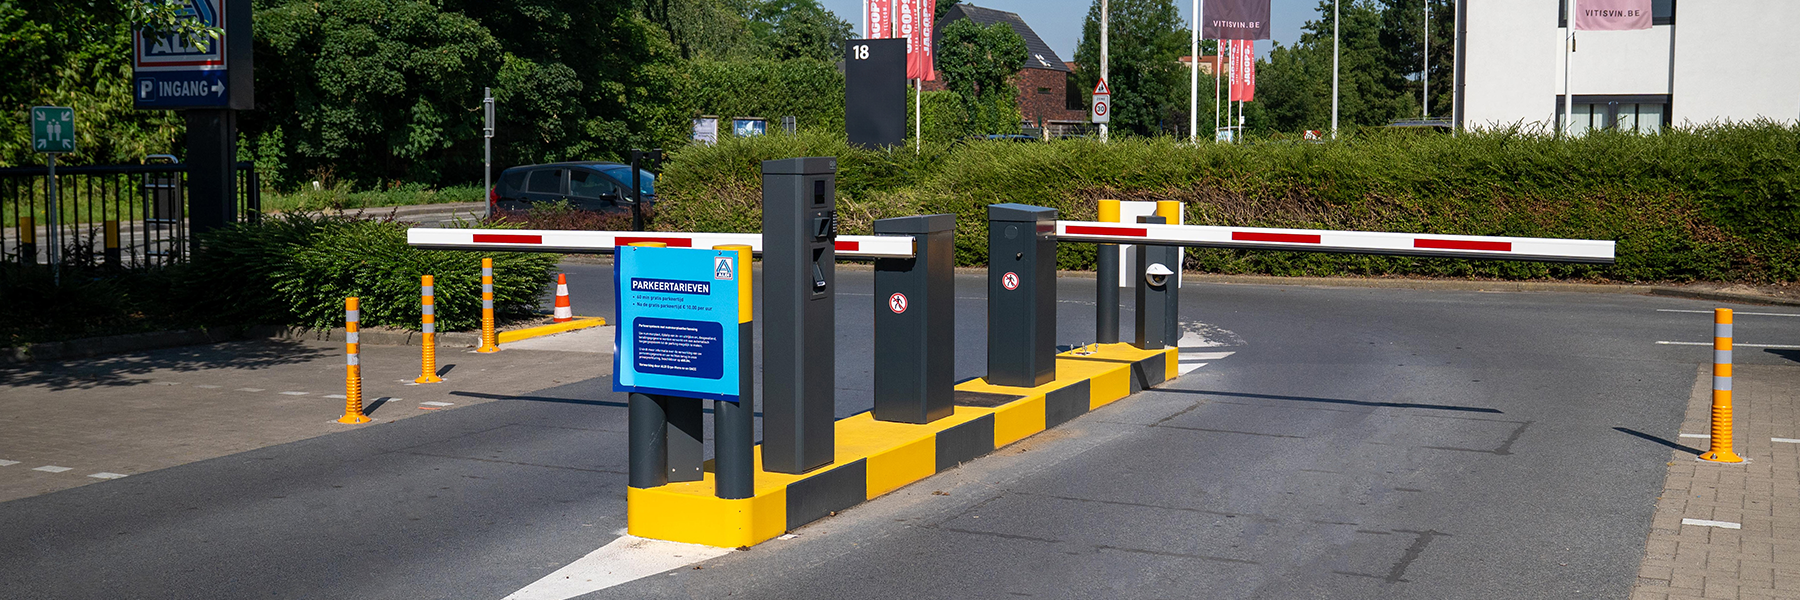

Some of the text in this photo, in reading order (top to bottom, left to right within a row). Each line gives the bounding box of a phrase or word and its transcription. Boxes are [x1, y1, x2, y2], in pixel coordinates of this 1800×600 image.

[1585, 9, 1640, 17] VITISVIN.BE
[1213, 20, 1260, 29] VITISVIN.BE
[852, 44, 870, 60] 18
[141, 80, 209, 98] P INGANG
[632, 280, 709, 293] PARKEERTARIEVEN
